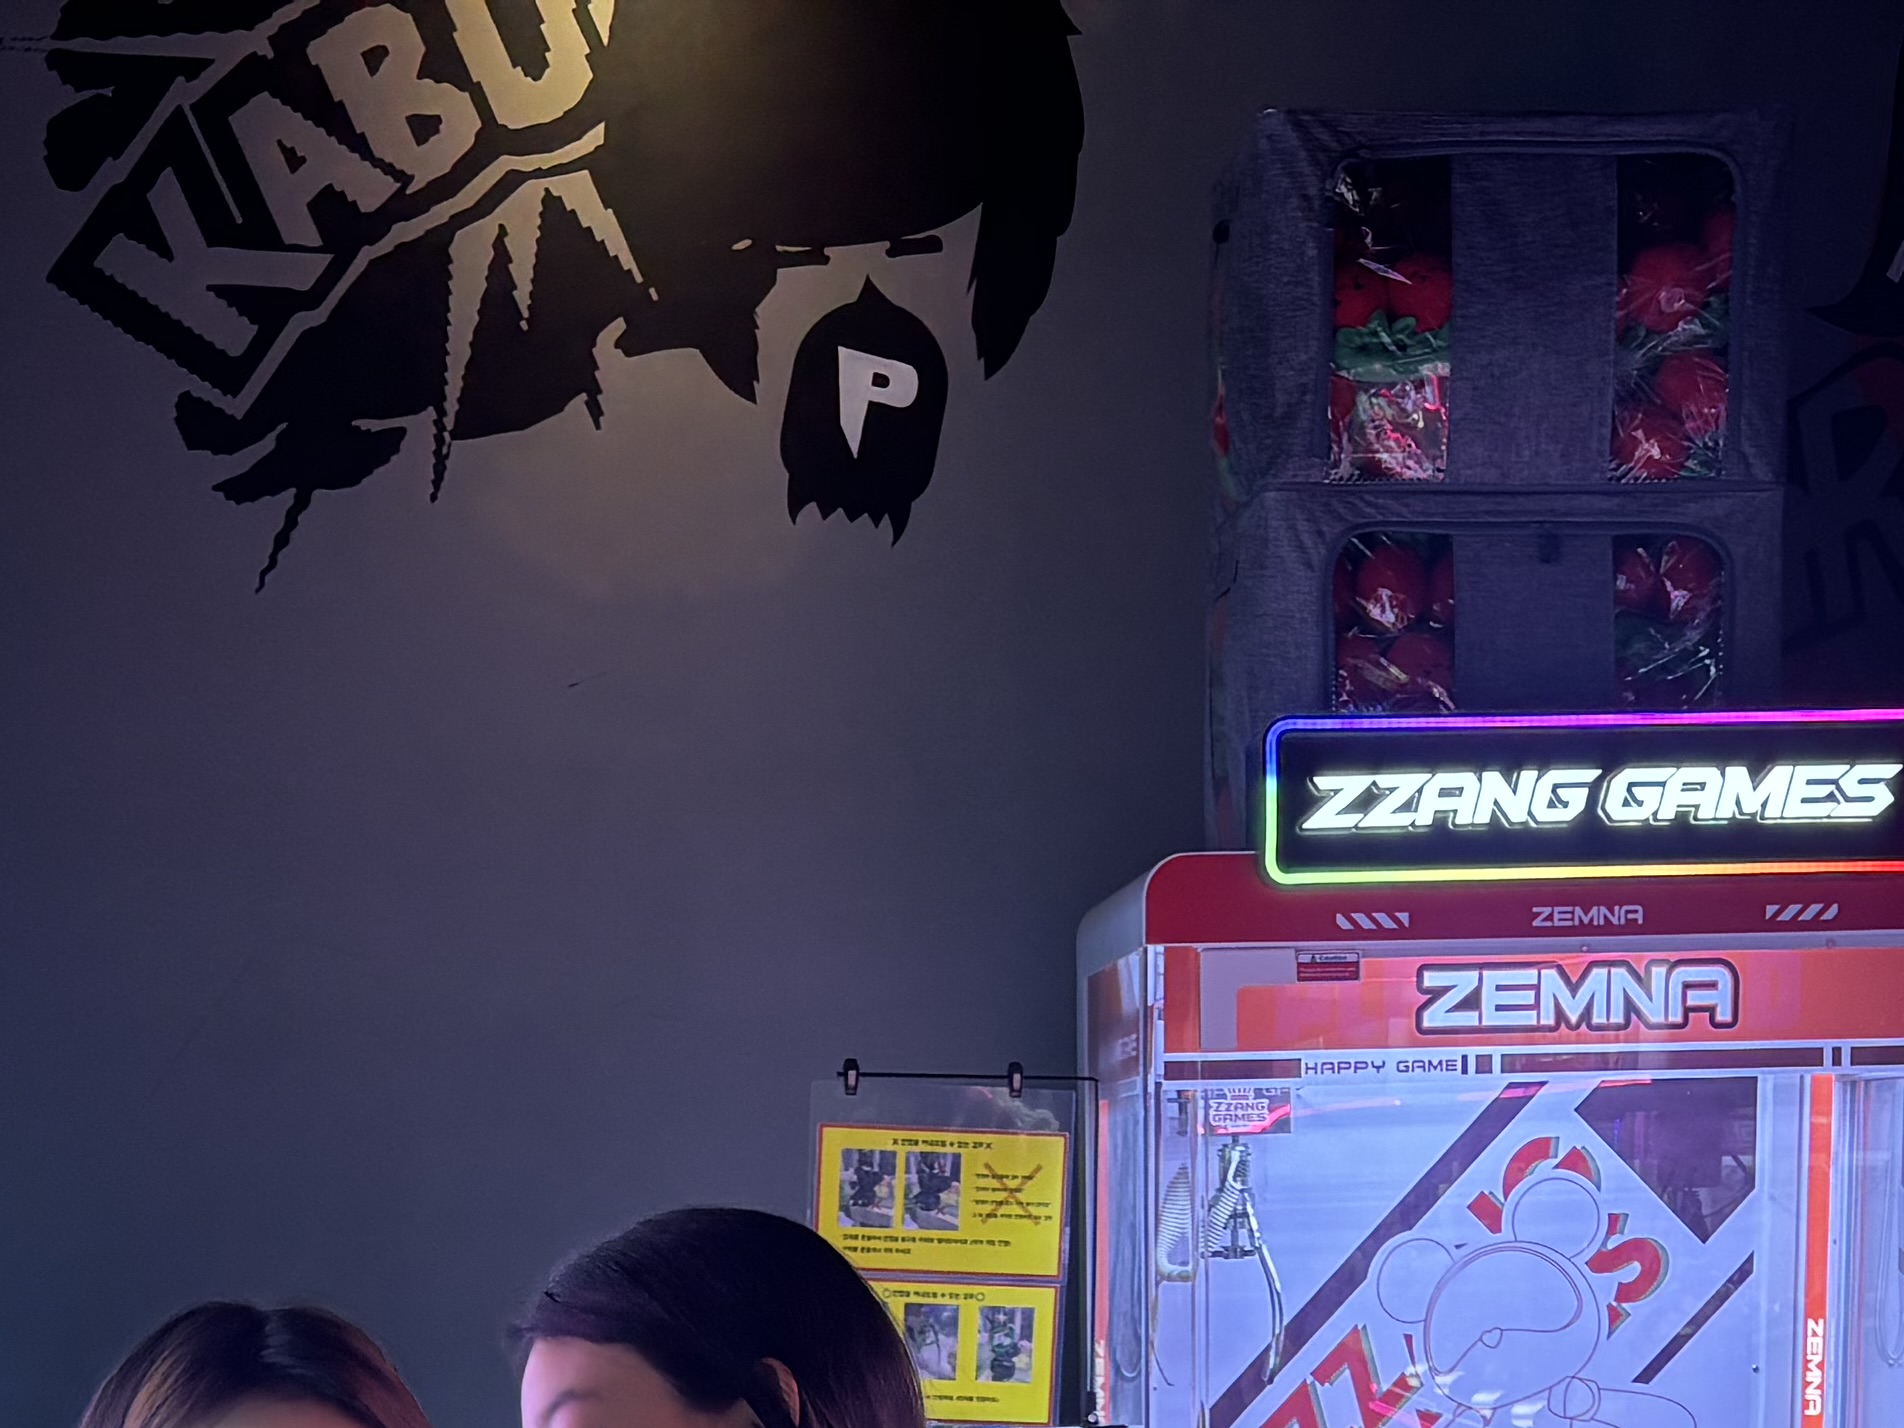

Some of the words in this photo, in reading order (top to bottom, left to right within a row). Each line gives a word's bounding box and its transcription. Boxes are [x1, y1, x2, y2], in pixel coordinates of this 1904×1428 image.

[1303, 769, 1602, 832] ZZANG
[1600, 763, 1904, 826] GAMES
[1531, 904, 1645, 927] ZEMNA
[1420, 964, 1737, 1029] ZEMNA
[1304, 1059, 1386, 1075] HAPPY
[1395, 1056, 1459, 1074] GAME
[1212, 1101, 1266, 1112] ZZANG
[1212, 1113, 1267, 1123] GAMES
[1804, 1317, 1825, 1417] ZEMNA
